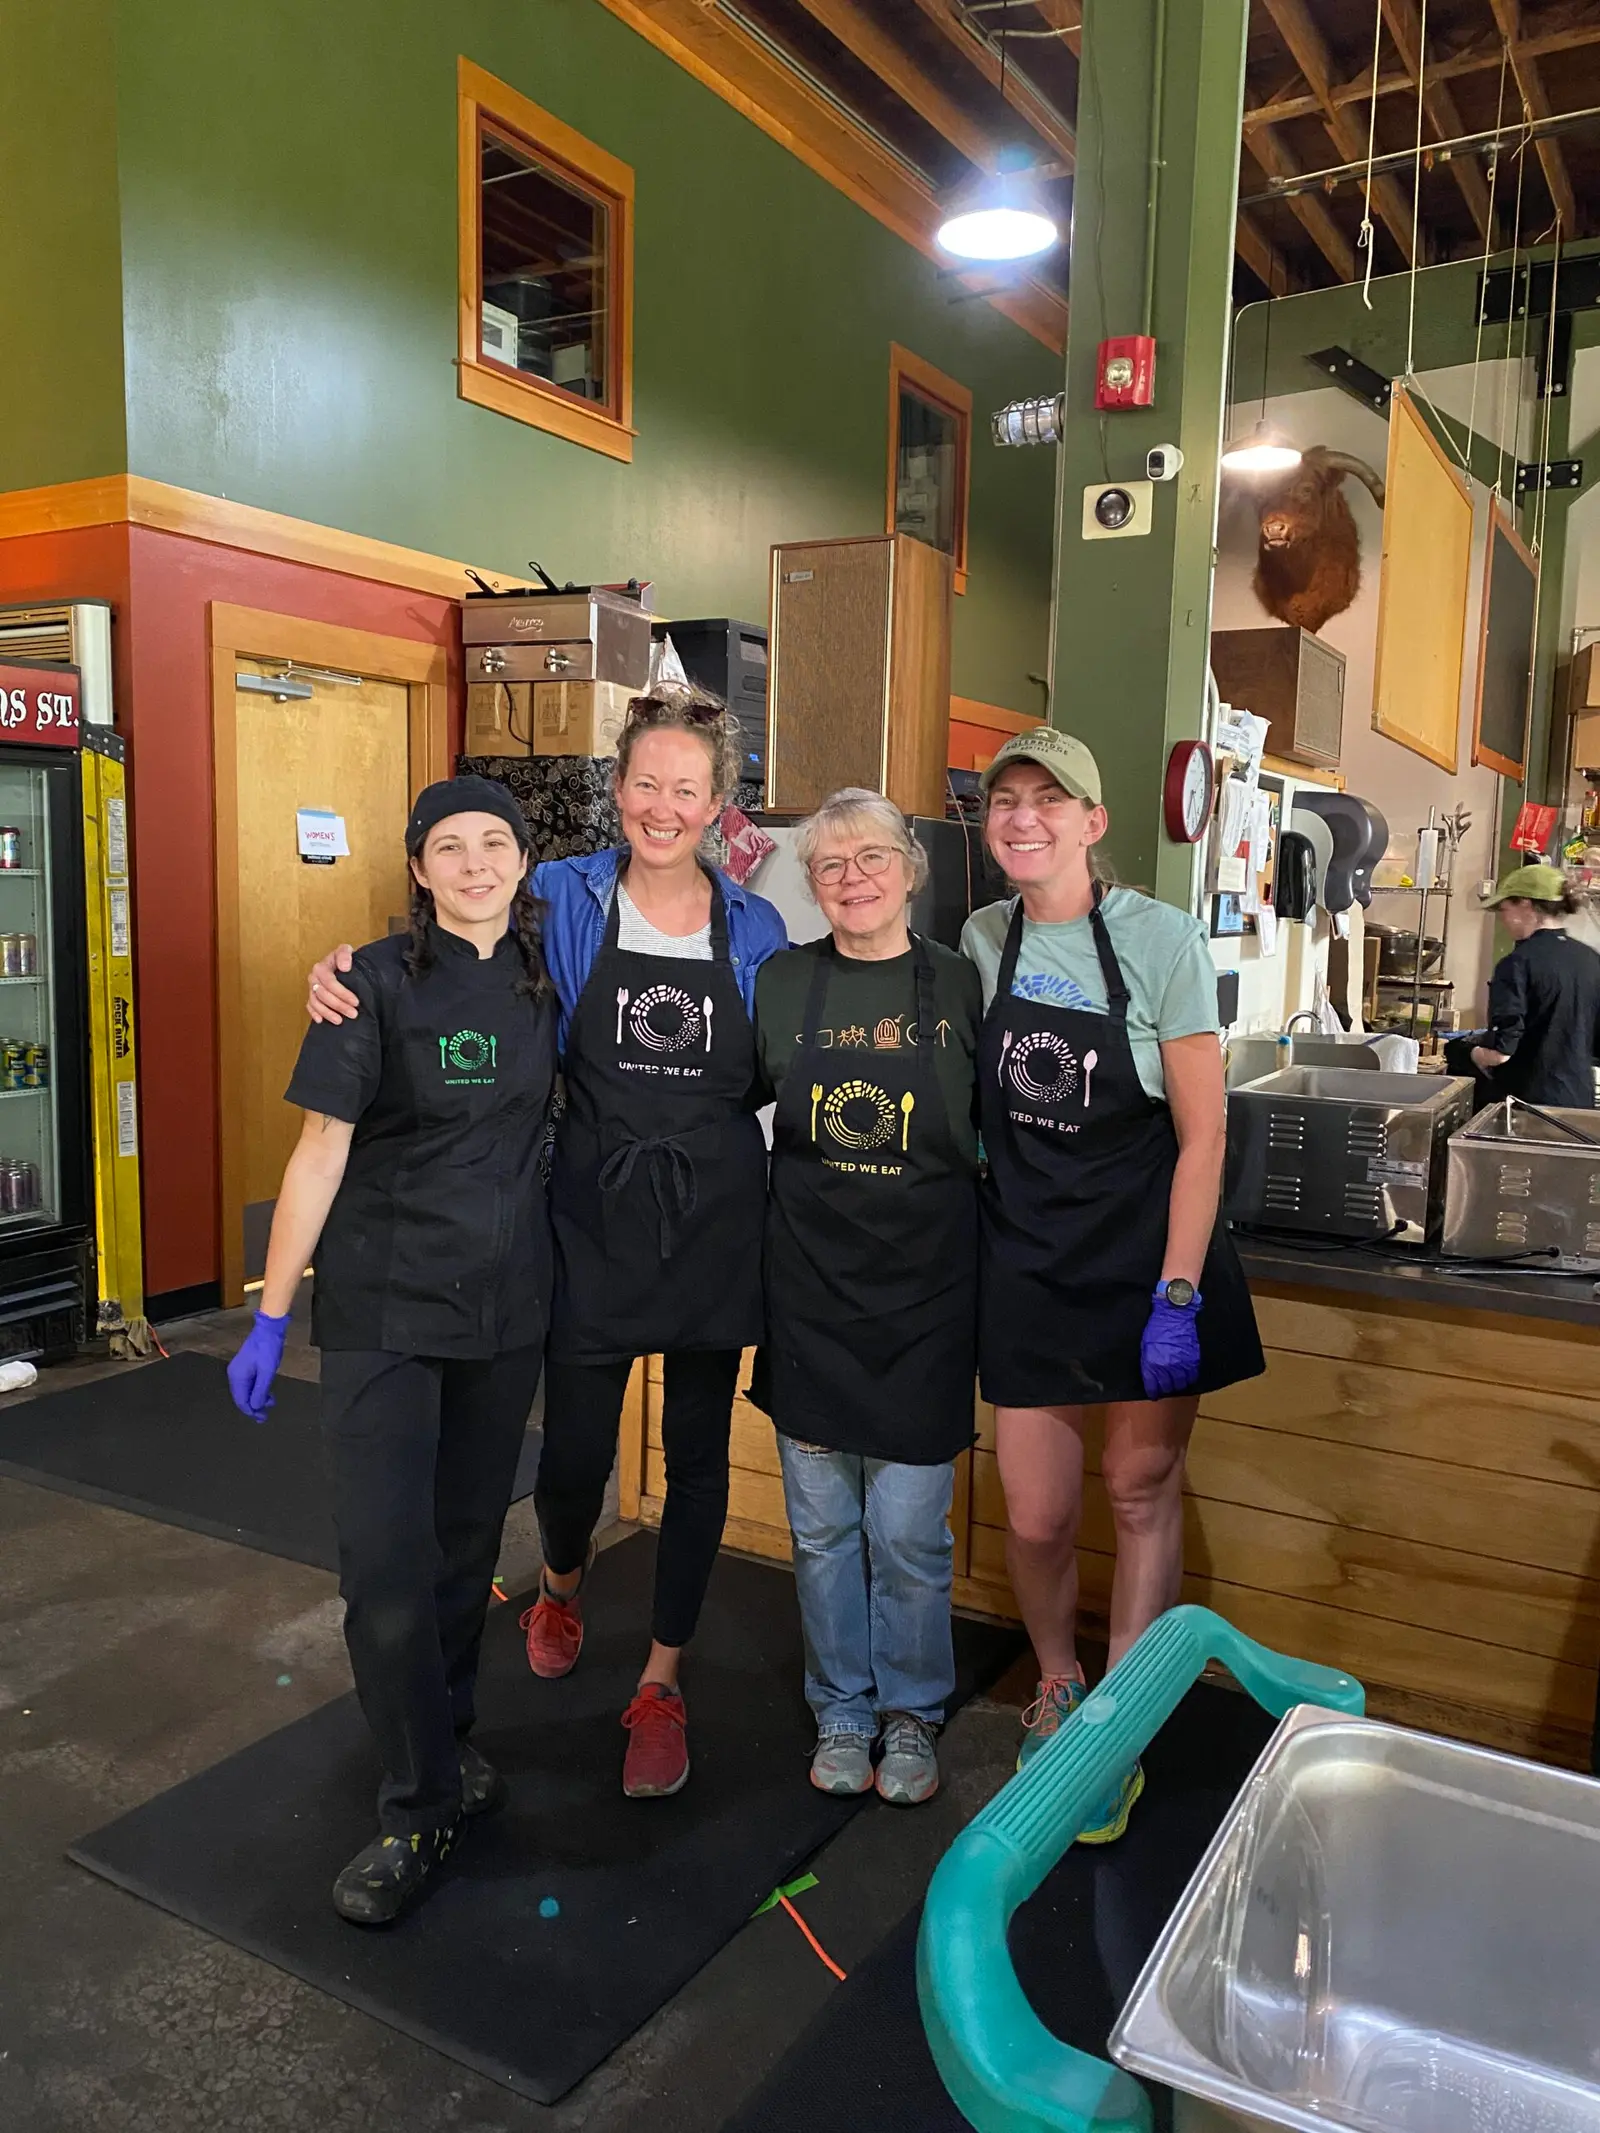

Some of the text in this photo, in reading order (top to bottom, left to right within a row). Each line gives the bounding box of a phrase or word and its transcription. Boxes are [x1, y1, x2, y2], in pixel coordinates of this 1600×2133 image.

[36, 692, 79, 731] ST.
[115, 1028, 123, 1059] RIVER
[619, 1060, 704, 1077] UNITED WE EAT
[1036, 1116, 1055, 1129] WE
[1058, 1122, 1081, 1134] EAT
[859, 1163, 878, 1174] WE
[881, 1165, 903, 1177] EAT
